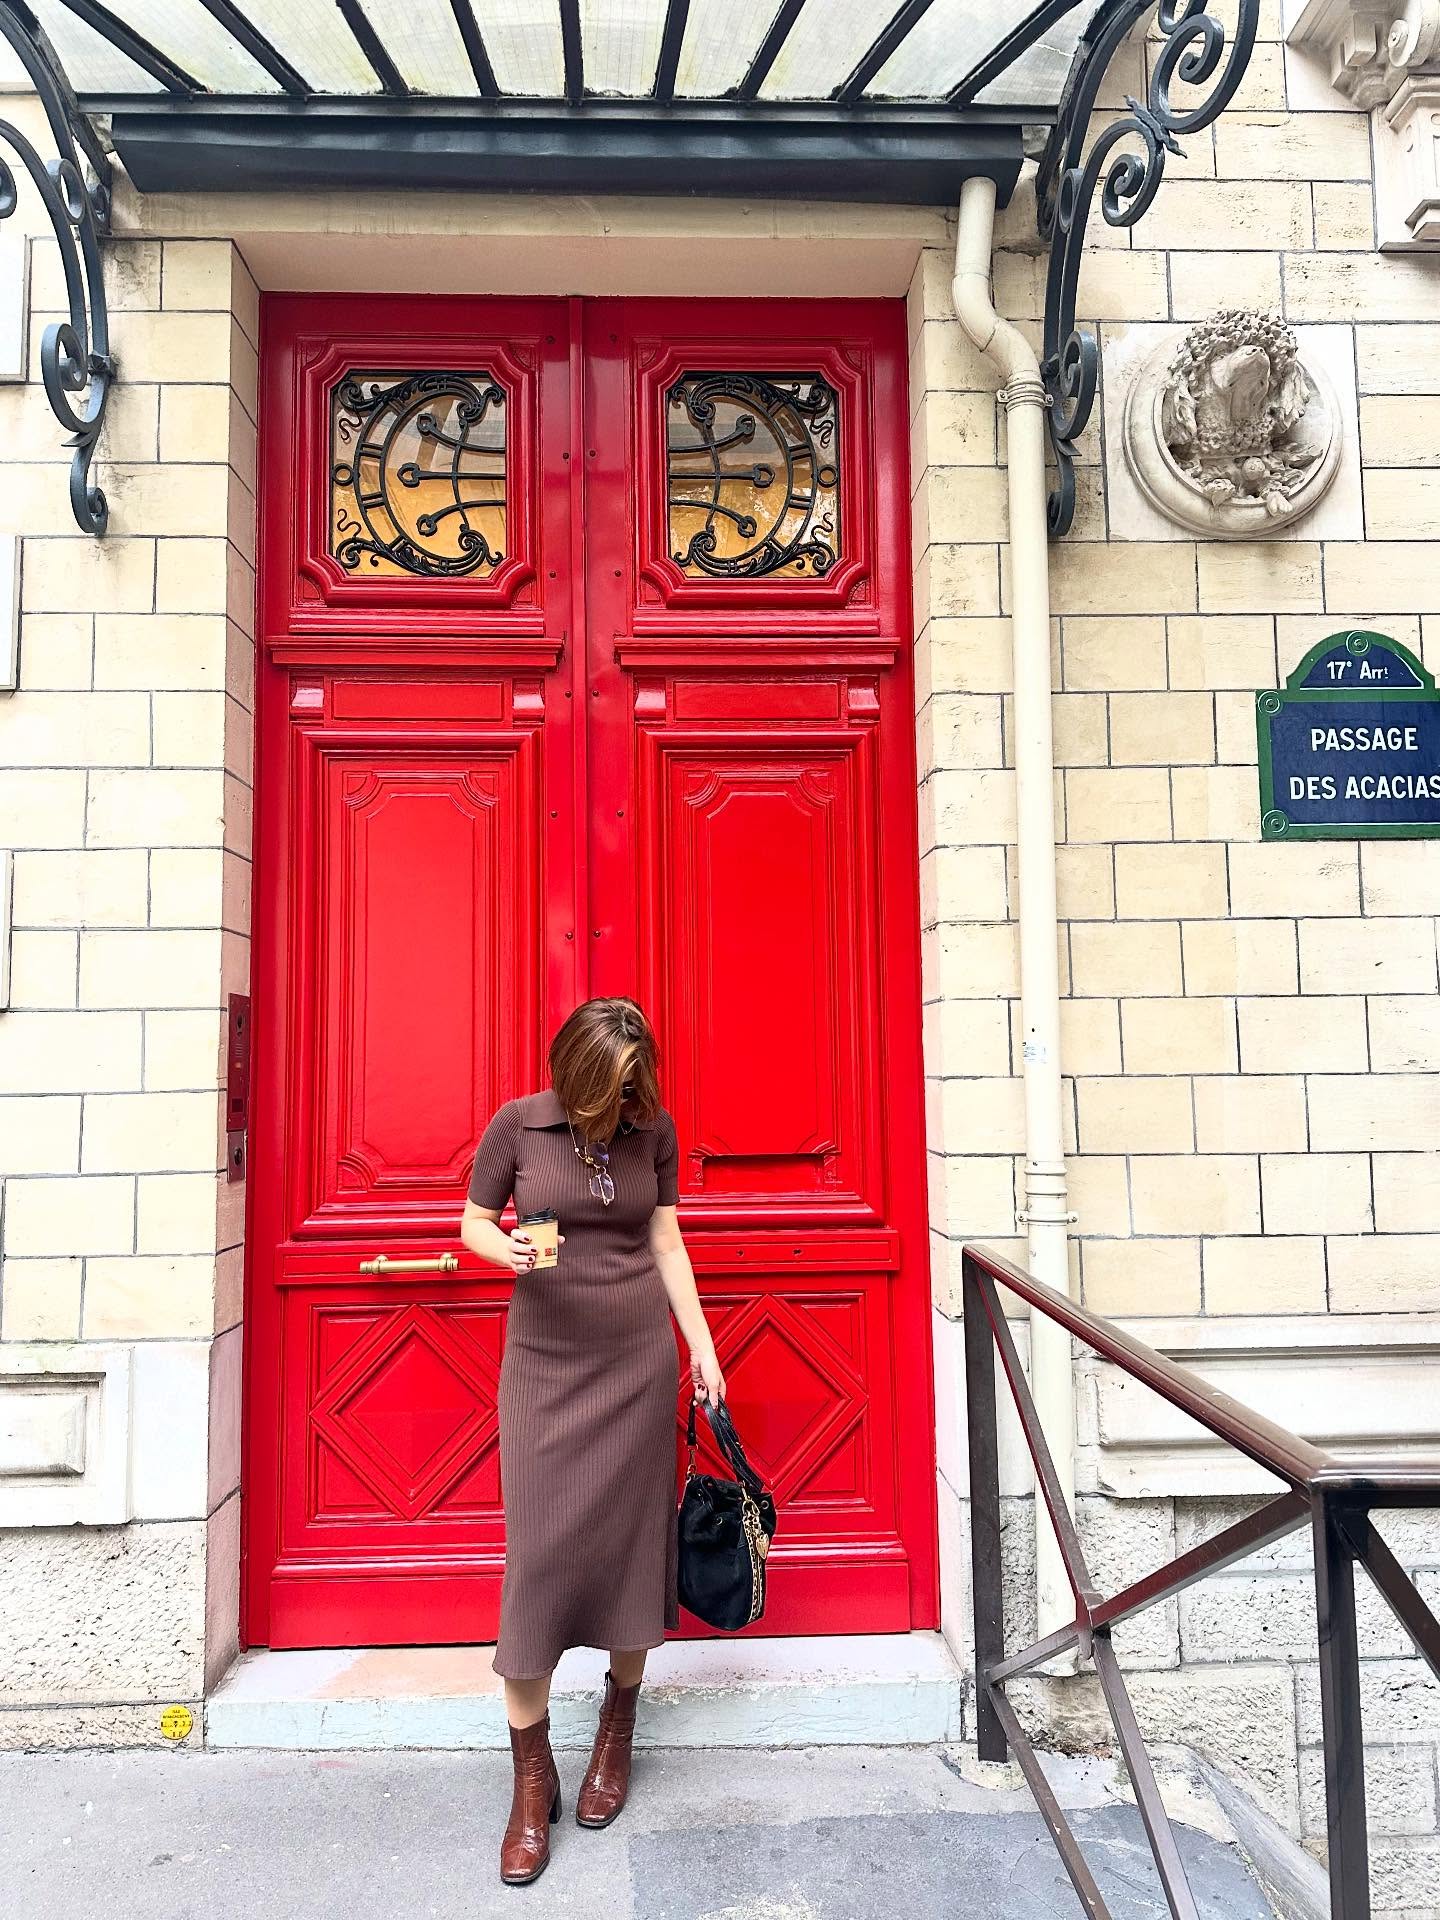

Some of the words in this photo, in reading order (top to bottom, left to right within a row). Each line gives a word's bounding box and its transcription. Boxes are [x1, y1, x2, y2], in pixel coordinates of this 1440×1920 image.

[1311, 727, 1419, 751] PASSAGE
[1289, 776, 1337, 800] DES
[1344, 775, 1440, 799] ACACIAS
